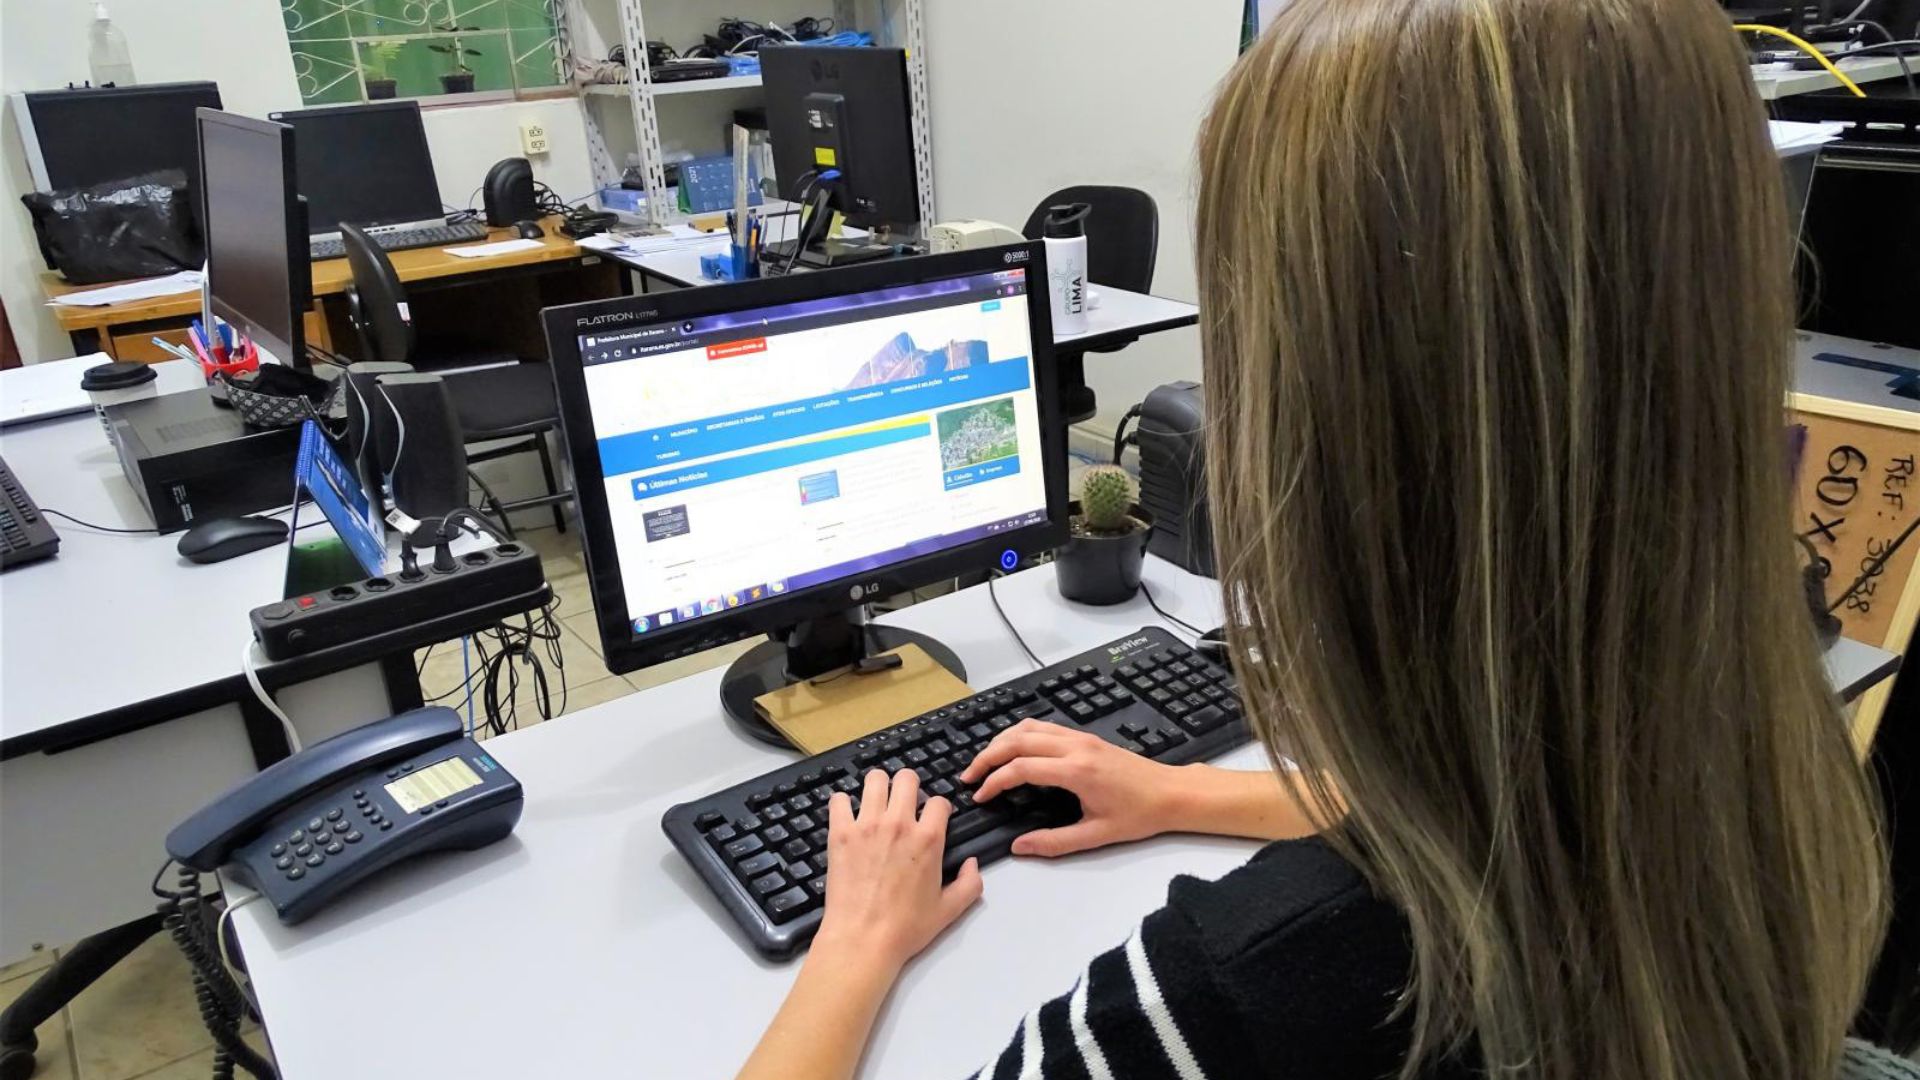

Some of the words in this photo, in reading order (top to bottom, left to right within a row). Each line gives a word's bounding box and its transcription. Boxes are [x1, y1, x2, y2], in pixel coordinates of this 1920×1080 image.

[1072, 276, 1082, 315] LIMA
[576, 312, 634, 327] FLATRON
[866, 583, 880, 595] LG
